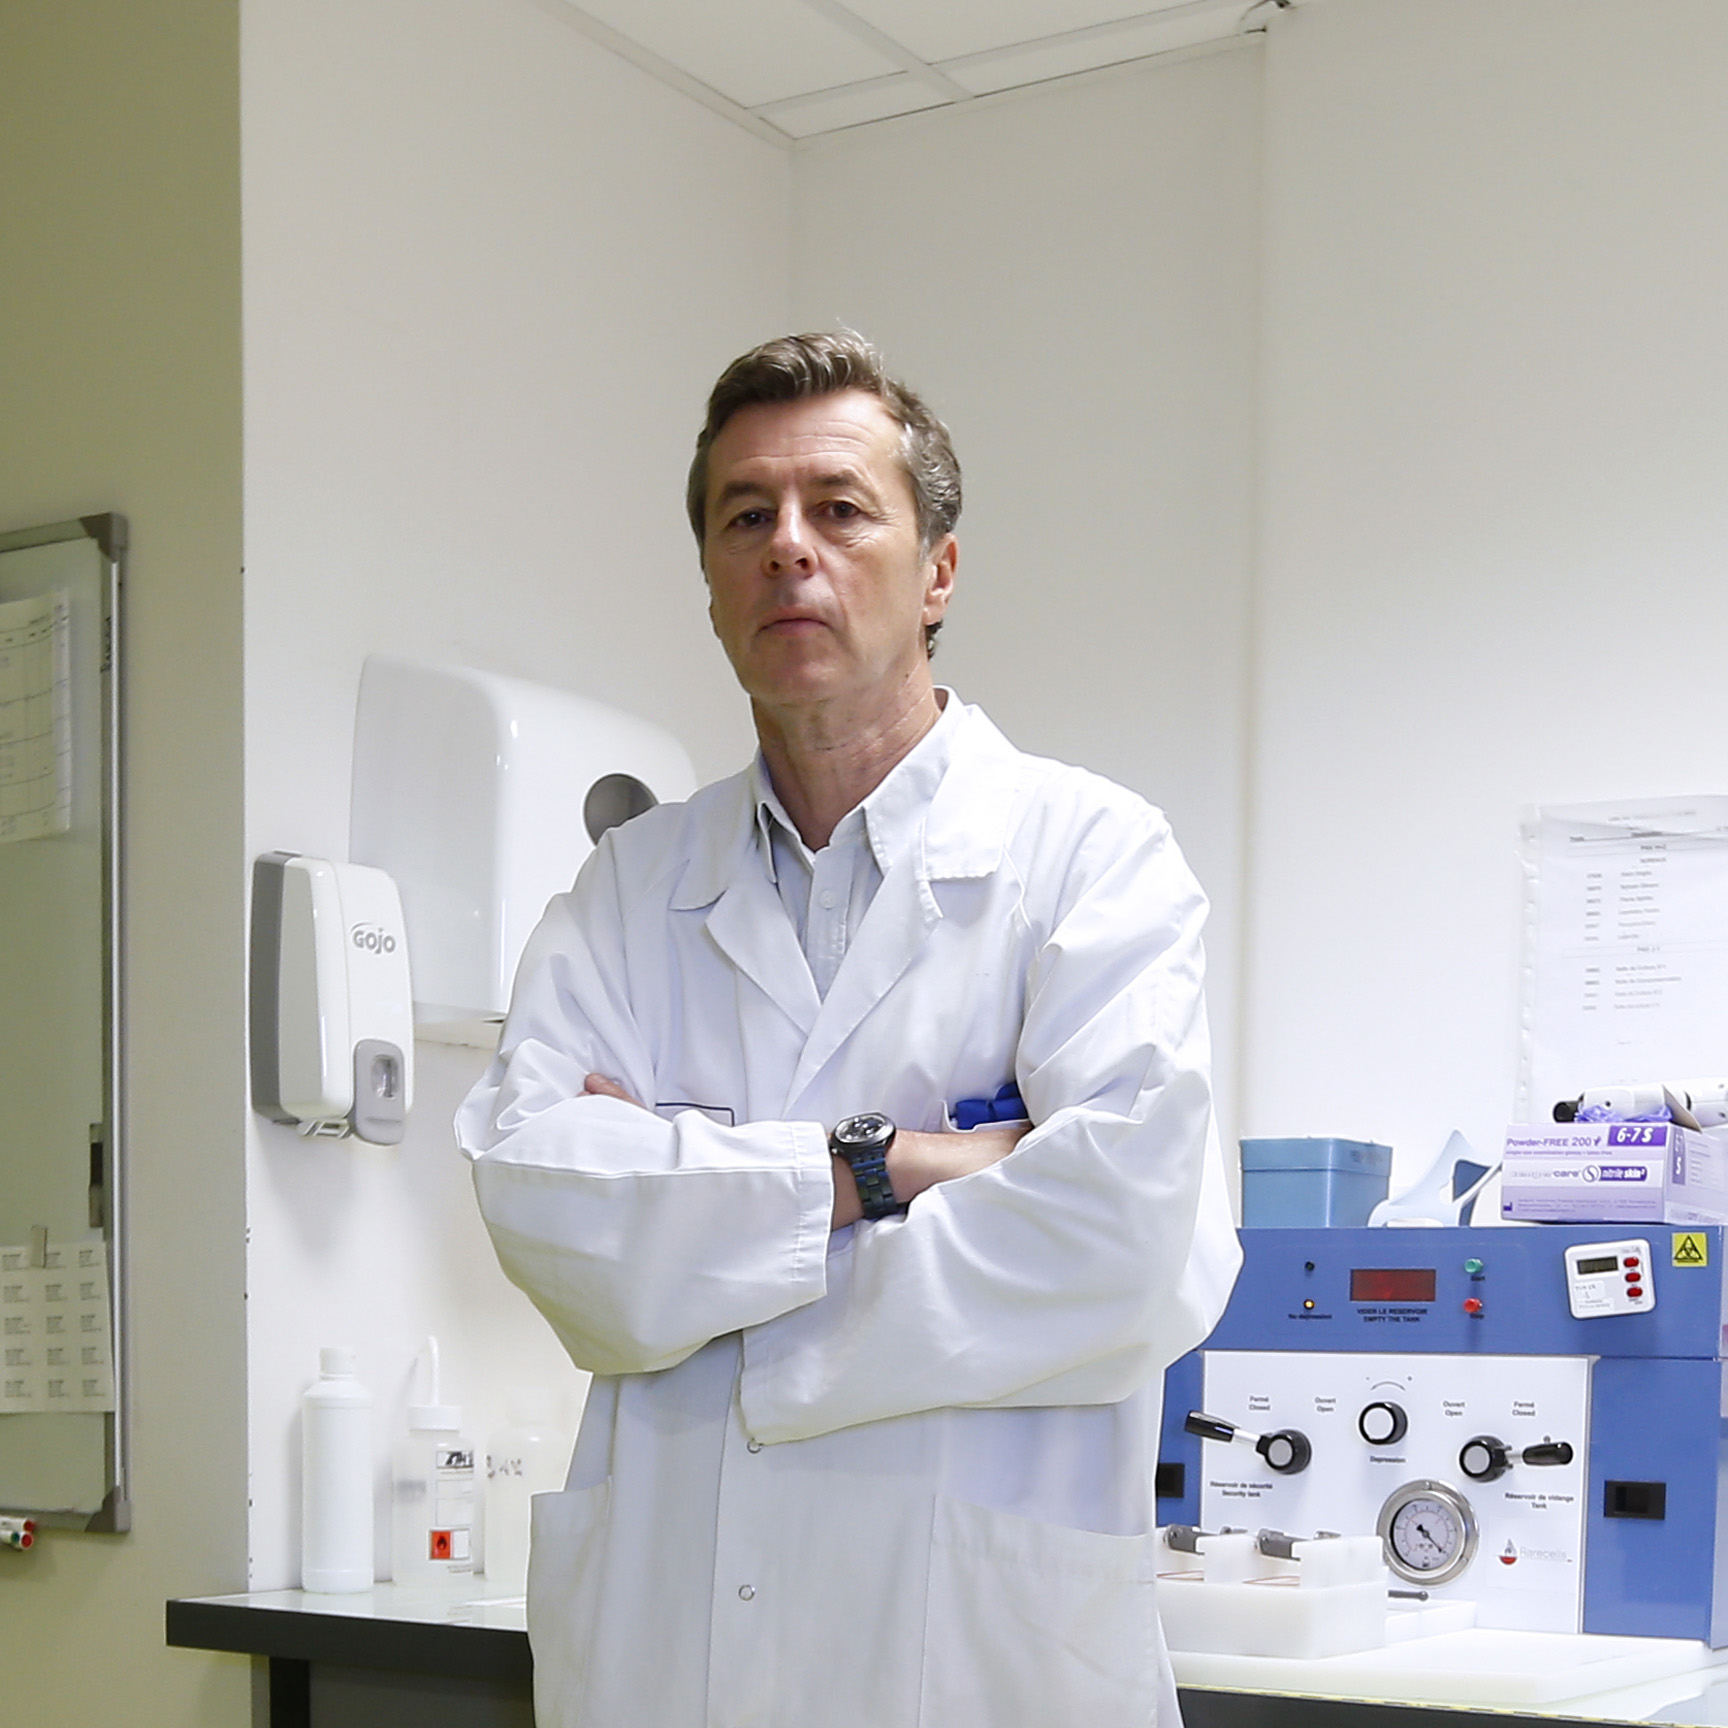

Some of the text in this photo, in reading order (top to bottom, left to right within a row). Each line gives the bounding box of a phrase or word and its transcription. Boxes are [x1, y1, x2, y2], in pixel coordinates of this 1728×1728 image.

[1572, 1136, 1592, 1146] 200
[1314, 1396, 1336, 1405] Ouvert
[1442, 1400, 1466, 1409] Ouvert
[1248, 1403, 1271, 1412] Closed
[1316, 1405, 1334, 1414] Open
[1444, 1409, 1463, 1417] Open
[1512, 1409, 1536, 1418] Closed
